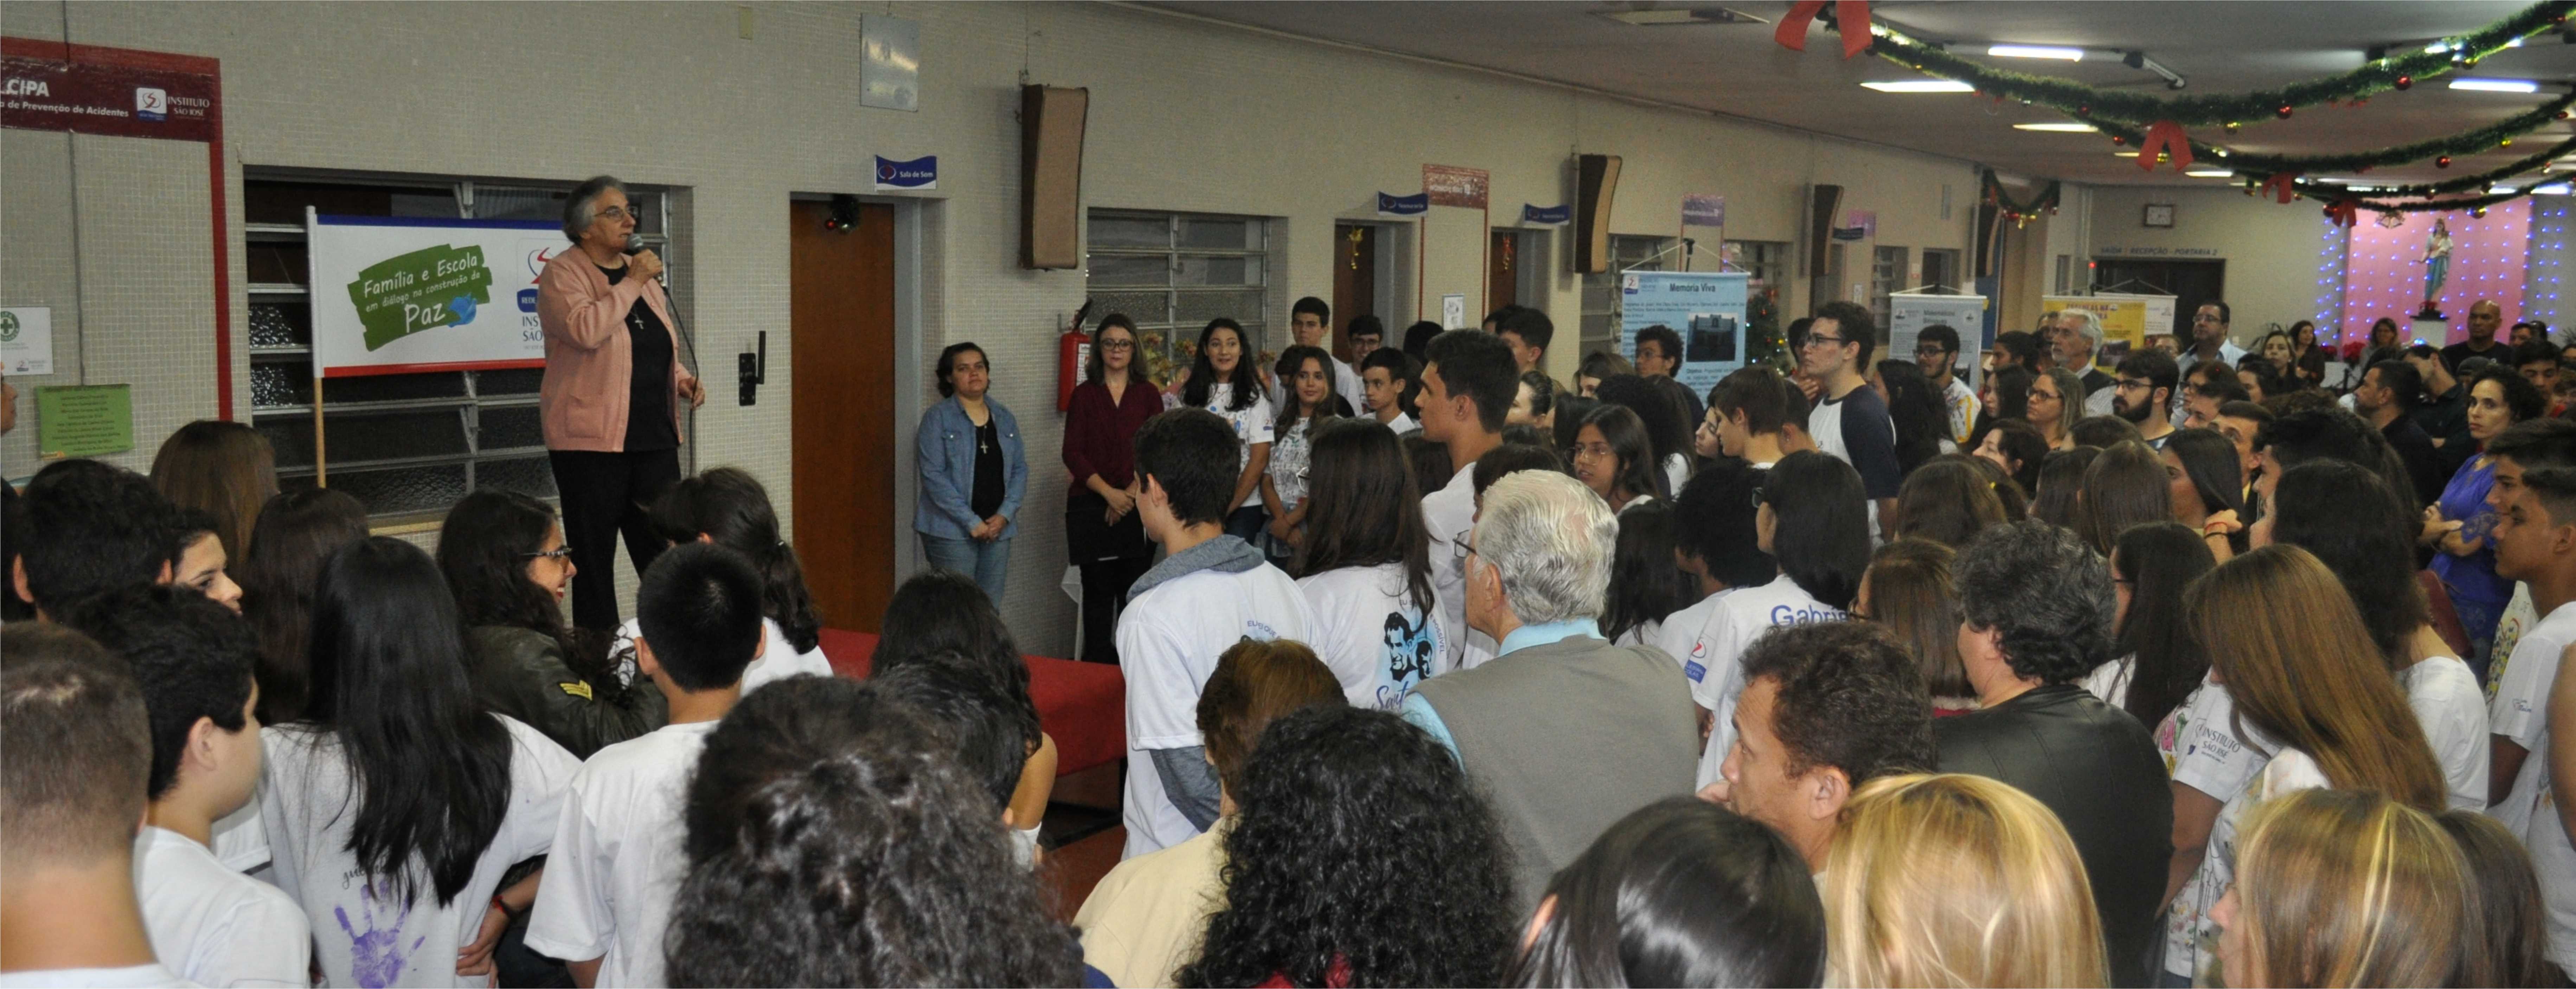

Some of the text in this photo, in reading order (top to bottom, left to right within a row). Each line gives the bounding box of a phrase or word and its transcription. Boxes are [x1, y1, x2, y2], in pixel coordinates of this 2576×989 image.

[7, 78, 50, 97] CIPA
[8, 100, 19, 109] de
[22, 101, 70, 114] Prevenção
[73, 105, 84, 114] de
[87, 106, 129, 117] Acidentes
[168, 96, 210, 108] INSTITUTO
[364, 252, 478, 298] Família e Escola
[366, 271, 481, 312] em diálogo na construção da
[1700, 283, 1716, 292] Viva
[404, 303, 446, 334] Paz
[523, 316, 539, 327] INS
[523, 328, 544, 342] SÃO
[1771, 604, 1848, 627] Gabrie
[2202, 726, 2241, 753] INSTITUTO
